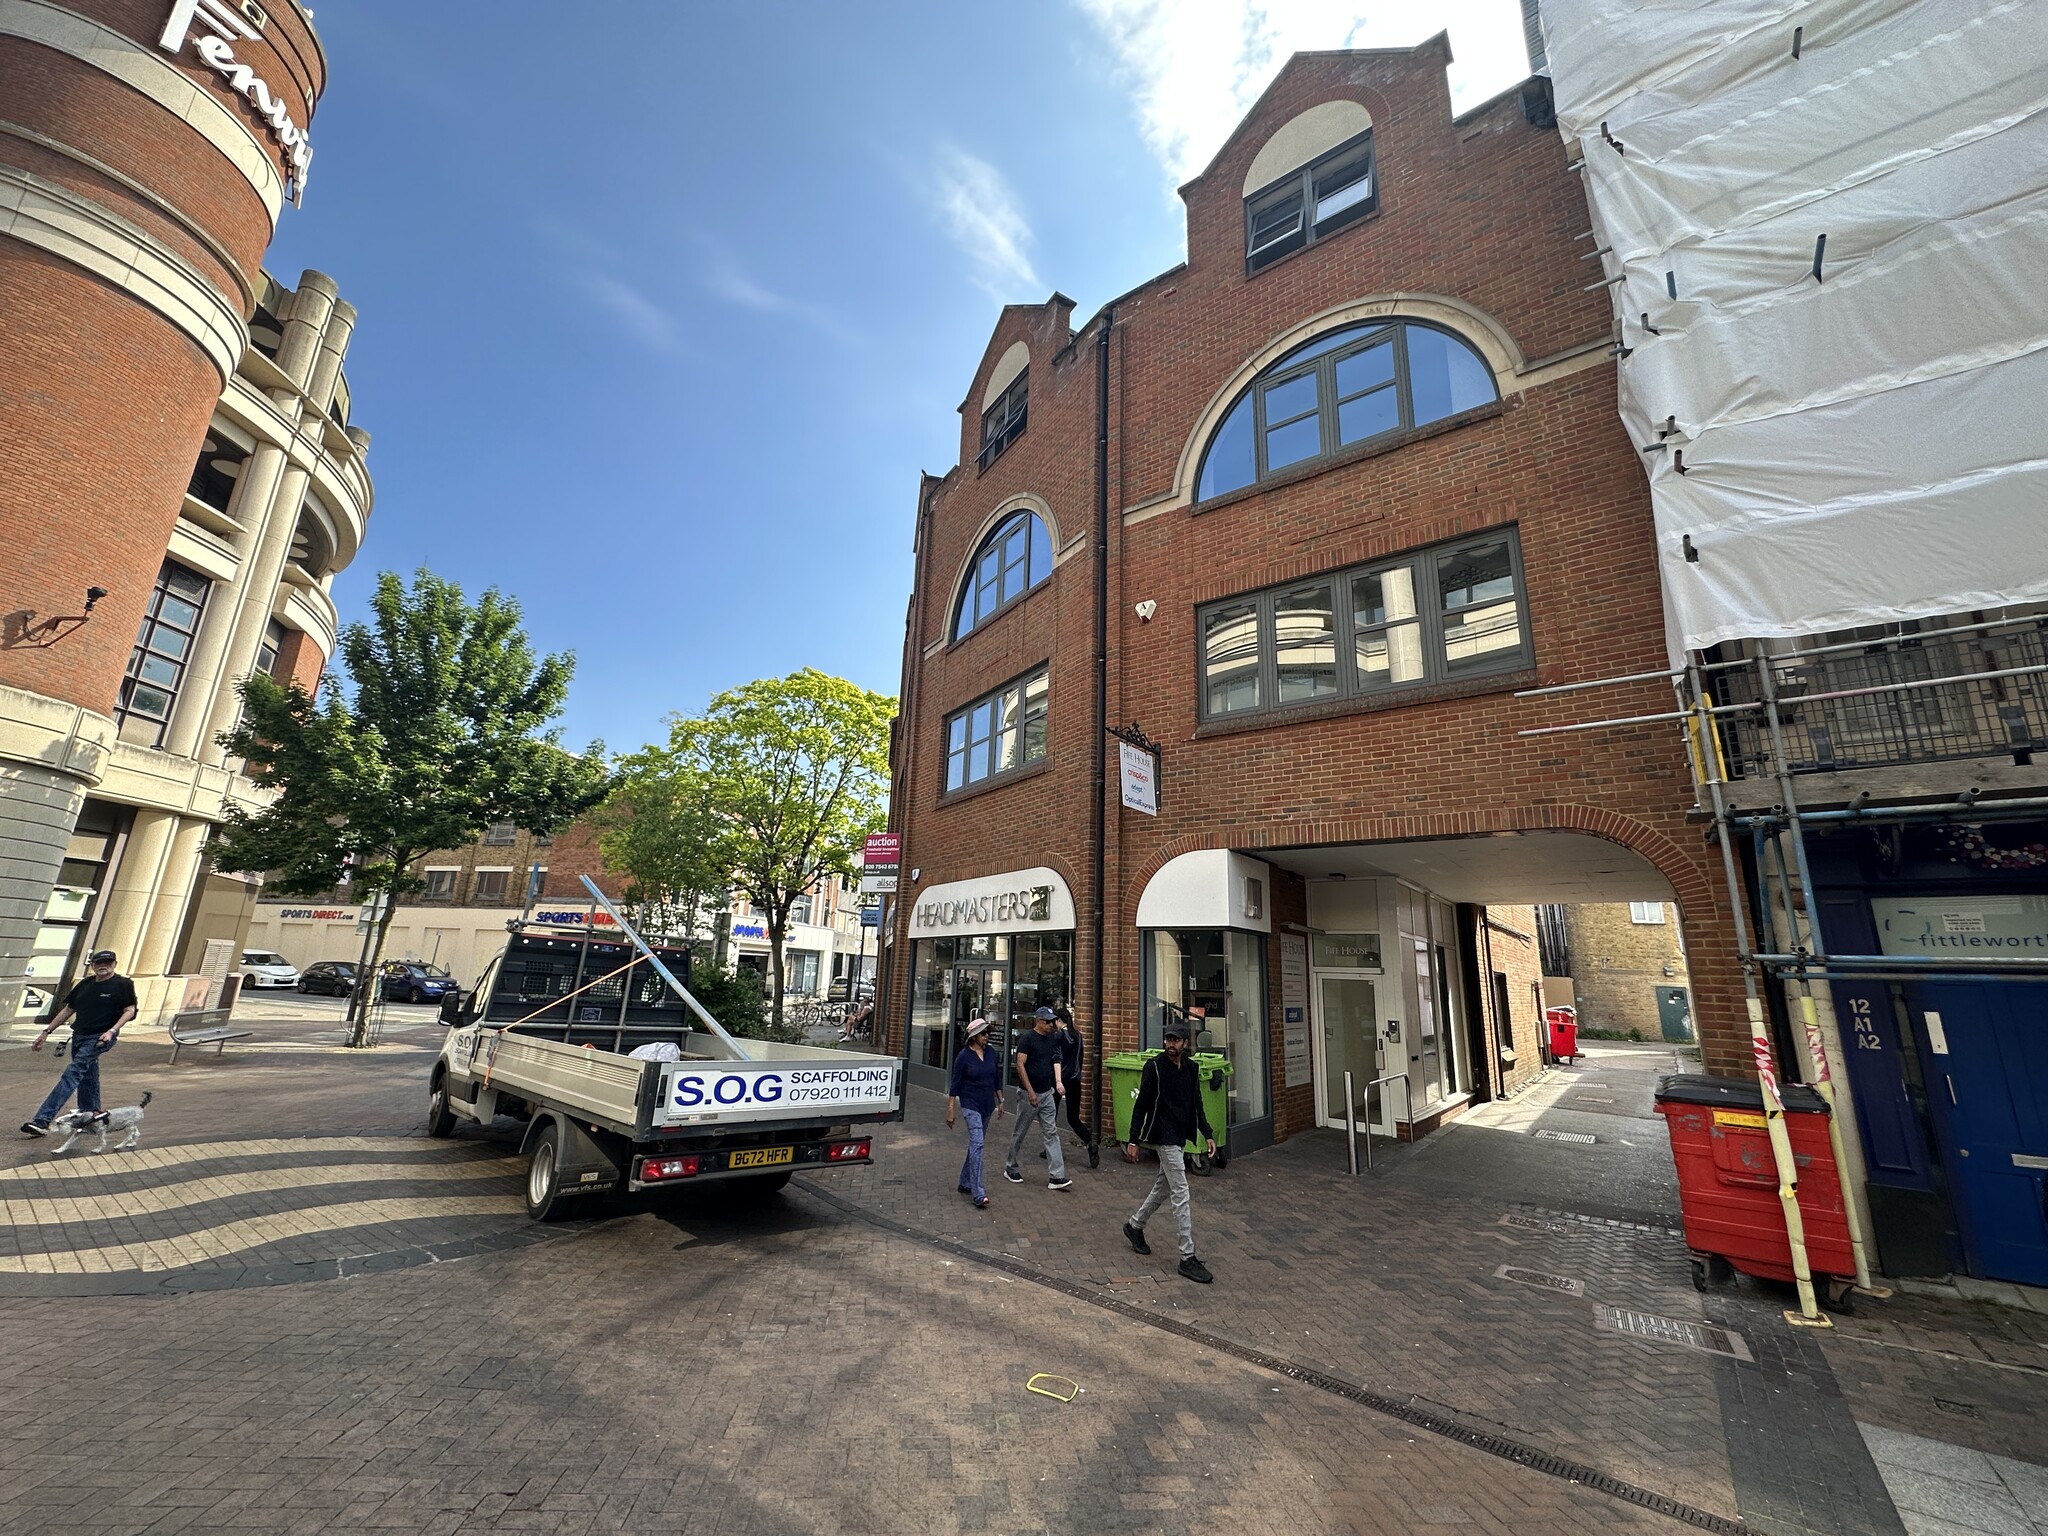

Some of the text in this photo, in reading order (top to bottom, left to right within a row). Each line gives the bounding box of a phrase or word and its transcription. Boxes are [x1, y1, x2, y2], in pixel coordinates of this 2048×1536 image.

[867, 837, 897, 846] auction
[916, 891, 1029, 927] HEADMASTERS
[1919, 934, 2048, 946] fittlewort
[1848, 998, 1871, 1014] 12
[1854, 1016, 1873, 1032] A1
[1858, 1034, 1882, 1050] A2
[790, 1070, 889, 1084] SCAFFOLDING
[674, 1074, 783, 1107] S.O.G
[789, 1085, 888, 1101] 07920 111 412
[734, 1148, 789, 1166] BG72 HFR
